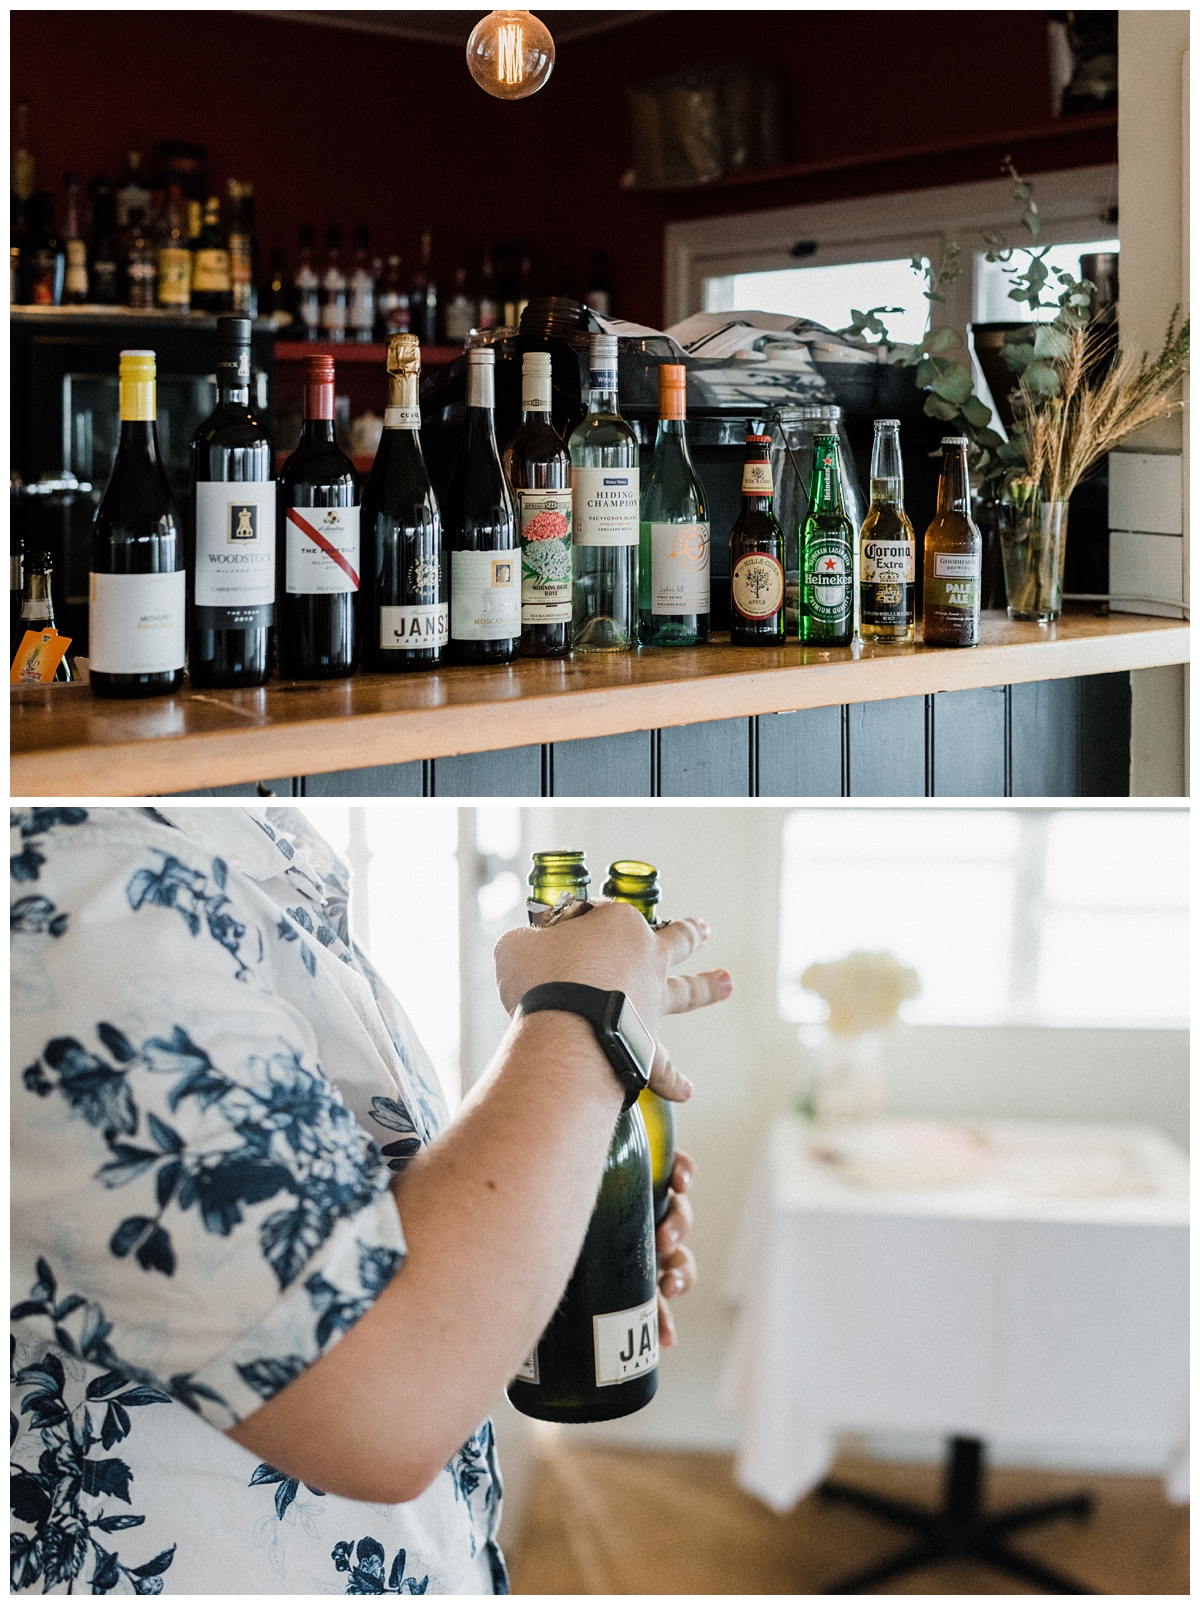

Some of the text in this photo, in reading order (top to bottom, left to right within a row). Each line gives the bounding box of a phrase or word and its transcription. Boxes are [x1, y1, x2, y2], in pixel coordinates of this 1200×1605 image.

[596, 491, 634, 499] HIDING
[587, 499, 638, 508] CHAMPION
[208, 552, 272, 564] WOODSTOCK
[864, 542, 912, 562] Corona
[743, 557, 764, 568] HILLS
[764, 559, 780, 578] CIDER
[876, 557, 904, 569] Extra
[805, 573, 853, 586] Heineken
[945, 583, 971, 594] PALE
[808, 595, 832, 614] PREMIUM
[948, 593, 969, 604] ALE
[473, 618, 509, 626] MOSCATO
